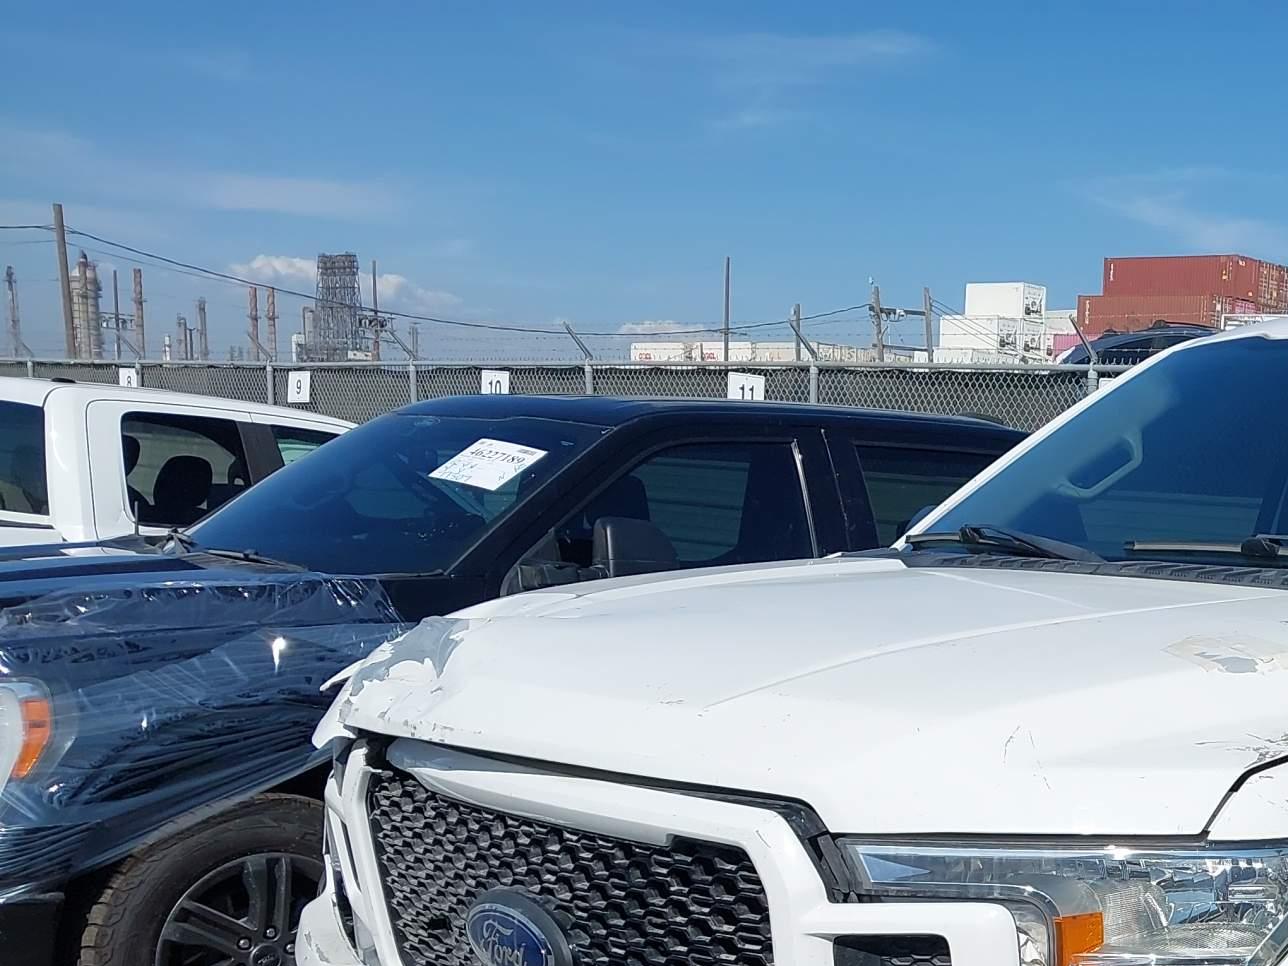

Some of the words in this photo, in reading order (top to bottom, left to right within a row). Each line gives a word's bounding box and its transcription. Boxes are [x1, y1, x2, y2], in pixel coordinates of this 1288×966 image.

[296, 379, 302, 395] 9
[488, 380, 502, 394] 10
[739, 383, 754, 400] 11
